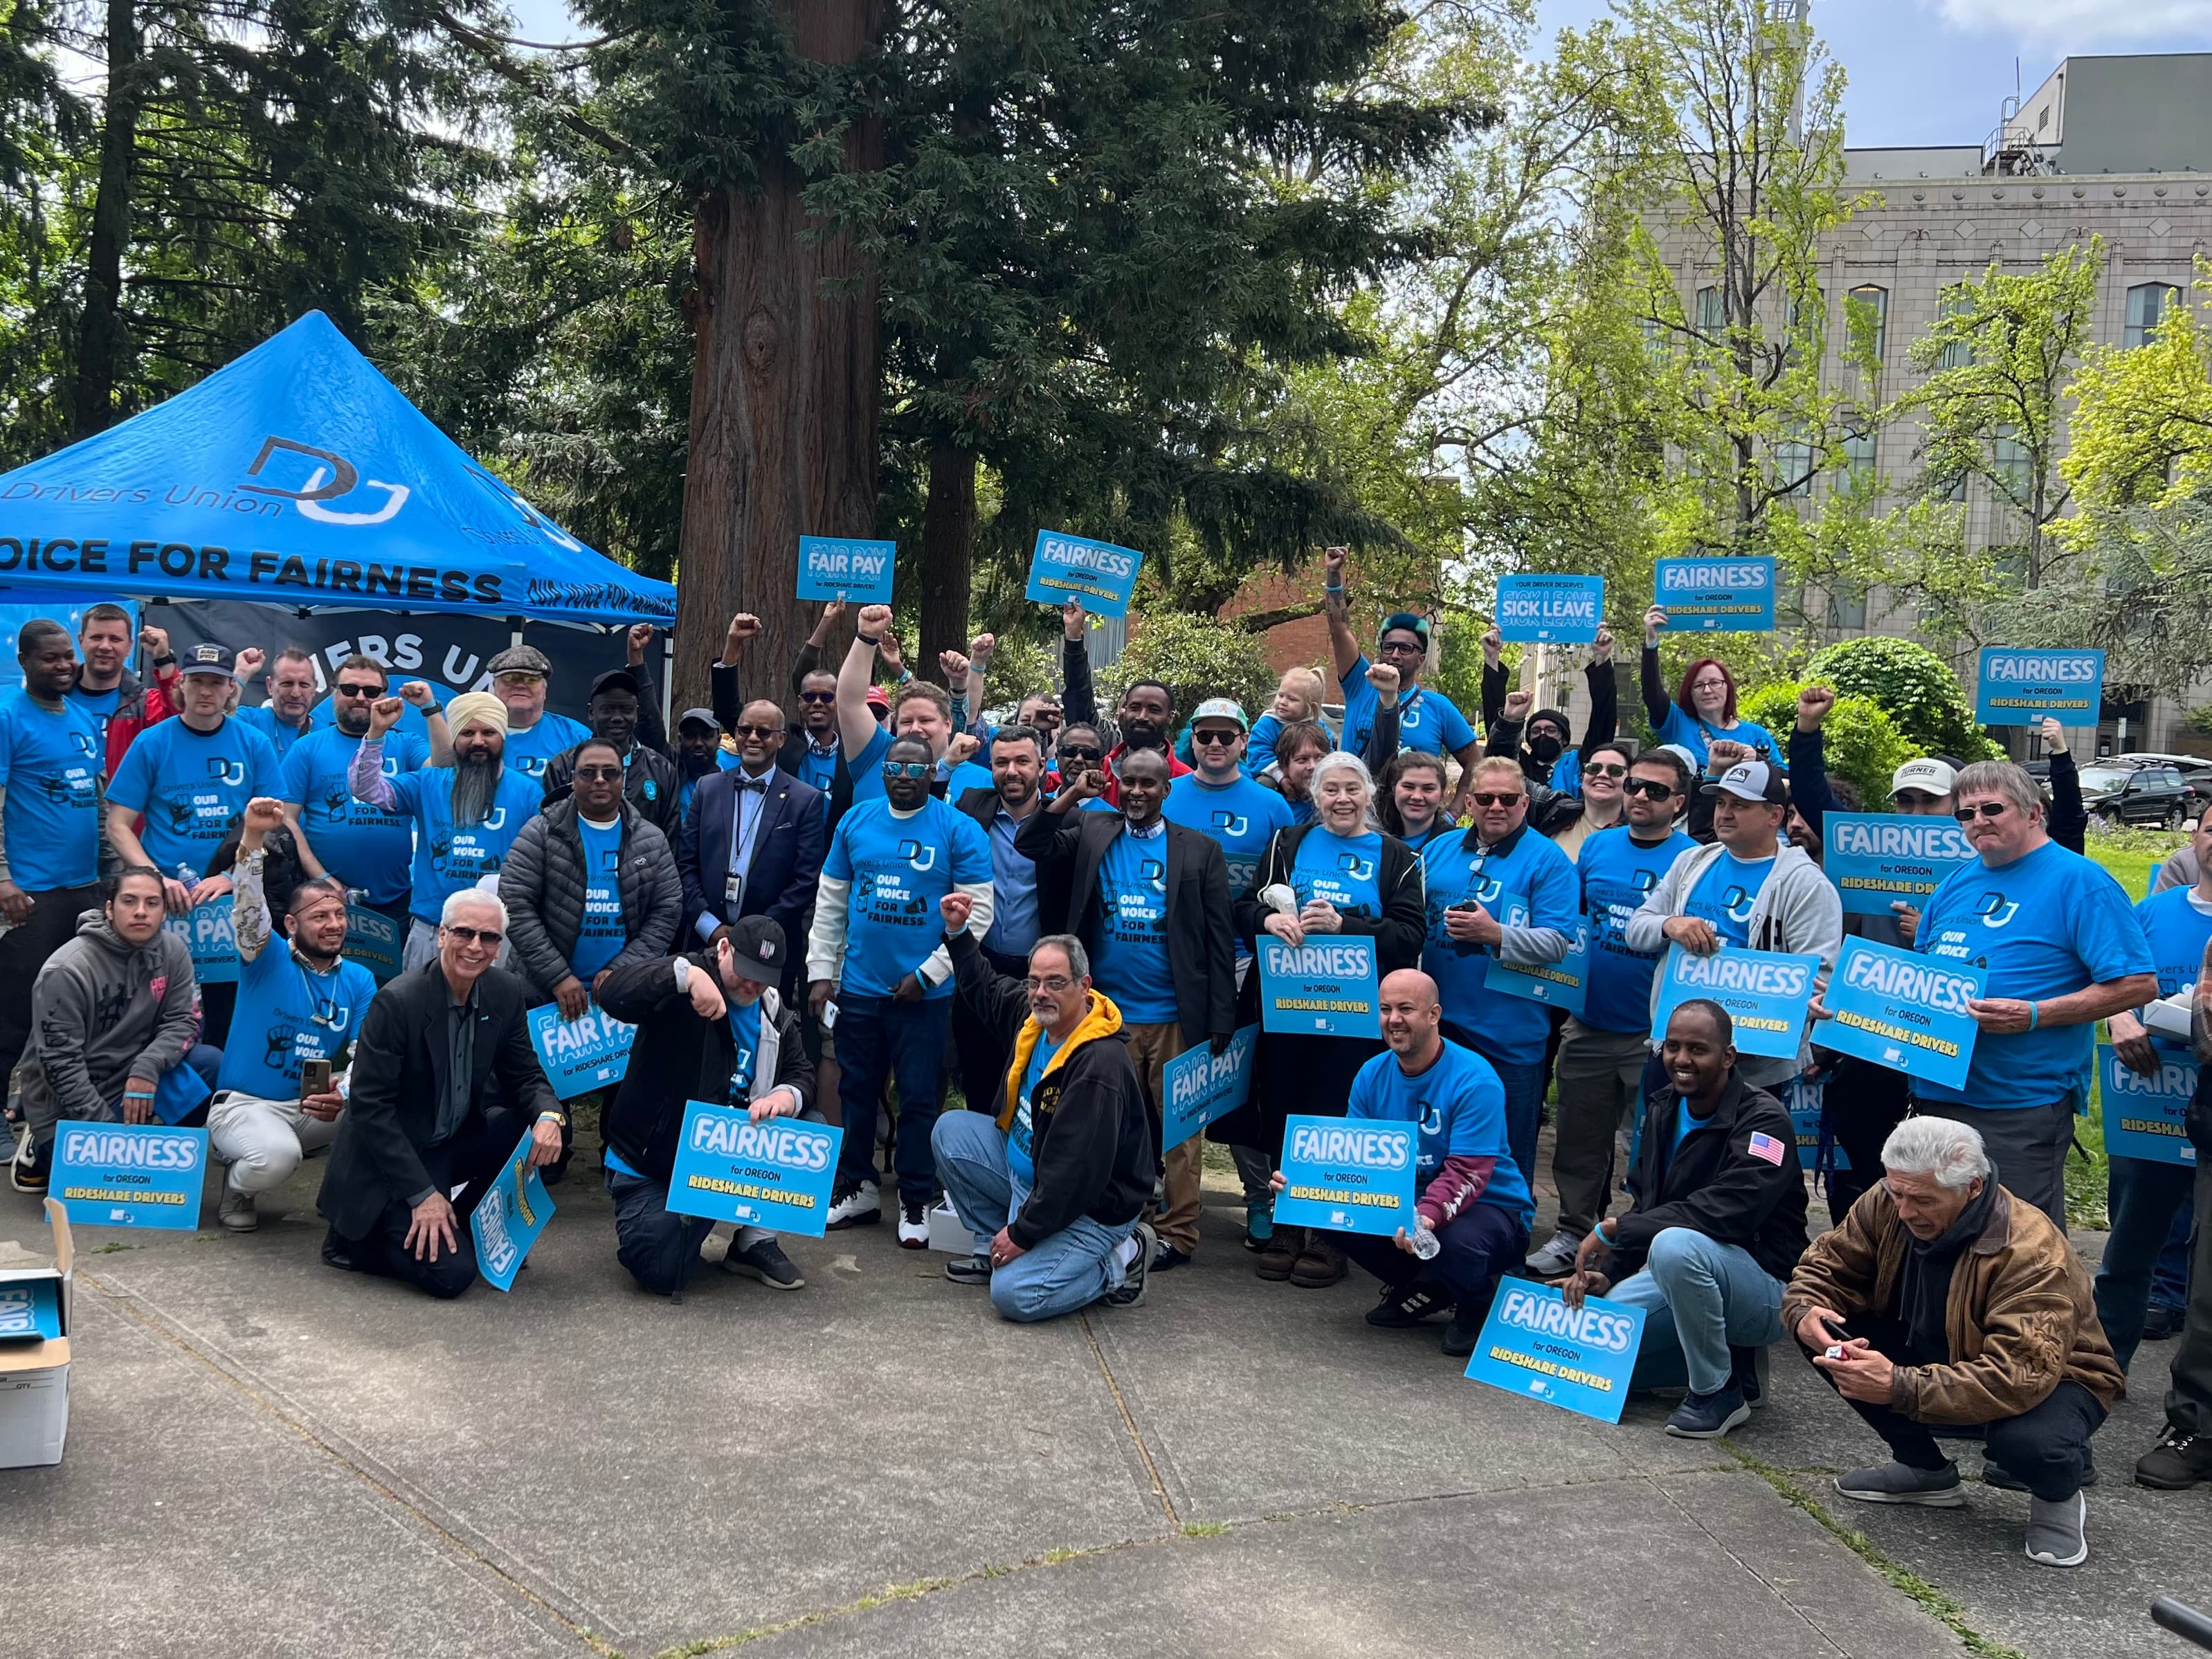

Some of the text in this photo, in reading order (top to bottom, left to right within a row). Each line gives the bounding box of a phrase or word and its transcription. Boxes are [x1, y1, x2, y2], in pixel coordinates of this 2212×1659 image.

[1, 482, 282, 517] Drivers Union
[808, 552, 886, 574] FAIR PAY
[1044, 541, 1132, 577] FAIRNESS
[0, 537, 502, 604] OICE FOR FAIRNESS
[1665, 566, 1766, 588] FAIRNESS
[1040, 577, 1119, 601] RIDESHARE DRIVERS
[1502, 600, 1595, 617] SICK LEAVE
[1667, 604, 1762, 615] RIDESHARE DRIVERS
[1990, 659, 2094, 680] FAIRNESS
[1990, 698, 2089, 709] RIDESHARE DRIVERS
[320, 772, 346, 781] Driver
[193, 795, 218, 805] OUR
[197, 806, 229, 817] VOICE
[199, 819, 221, 828] FOR
[192, 831, 229, 840] FAIRN
[453, 835, 476, 845] OUR
[453, 847, 485, 858] VOICE
[453, 859, 473, 867] FOR
[1880, 864, 1932, 876] for OREGON
[446, 869, 484, 879] FAIRN
[876, 874, 900, 886] OUR
[1313, 879, 1340, 889] OUR
[1840, 877, 1913, 894] RIDESHARE
[586, 889, 609, 899] OUR
[877, 887, 911, 900] VOICE
[1121, 895, 1145, 905] OUR
[1314, 889, 1351, 903] VOICE
[586, 903, 619, 912] VOICE
[875, 900, 898, 912] FOR
[1121, 907, 1157, 918] VOICE
[586, 917, 608, 925] FOR
[1122, 921, 1145, 930] FOR
[196, 918, 233, 943] PA
[1941, 931, 1966, 943] OUR
[1116, 933, 1168, 943] FAIRNES
[1936, 944, 1970, 958] VOICE
[1268, 948, 1369, 976] FAIRNESS
[1550, 970, 1579, 988] DRIVERS
[1678, 954, 1806, 995] FAIRNESS
[1303, 984, 1341, 993] for OREGON
[1849, 954, 1976, 1013] FAIRNESS
[1276, 997, 1370, 1014] RIDESHARE DRIVERS
[1725, 998, 1759, 1010] OREGON
[1885, 1006, 1932, 1026] for OREGON
[1739, 1017, 1789, 1033] DRIVERS
[296, 1033, 320, 1046] OUR
[543, 1017, 600, 1057] FAIR
[1835, 1009, 1959, 1058] RIDESHARE DRIVERS
[295, 1046, 325, 1058] VOICE
[575, 1054, 615, 1073] RIDESHARE
[1172, 1046, 1245, 1105] FAIR PAY
[695, 1118, 828, 1168] FAIRNESS
[1294, 1130, 1406, 1166] FAIRNESS
[67, 1134, 195, 1168] FAIRNESS
[103, 1174, 150, 1184] for OREGON
[731, 1165, 781, 1182] for OREGON
[1324, 1172, 1368, 1184] for OREGON
[65, 1187, 186, 1206] RIDESHARE DRIVERS
[687, 1175, 815, 1209] RIDESHARE DRIVERS
[1289, 1186, 1400, 1209] RIDESHARE DRIVERS
[1503, 1293, 1631, 1350] FAIRNESS
[1533, 1341, 1581, 1361] for OREGON
[1489, 1346, 1613, 1392] RIDESHARE DRIVERS
